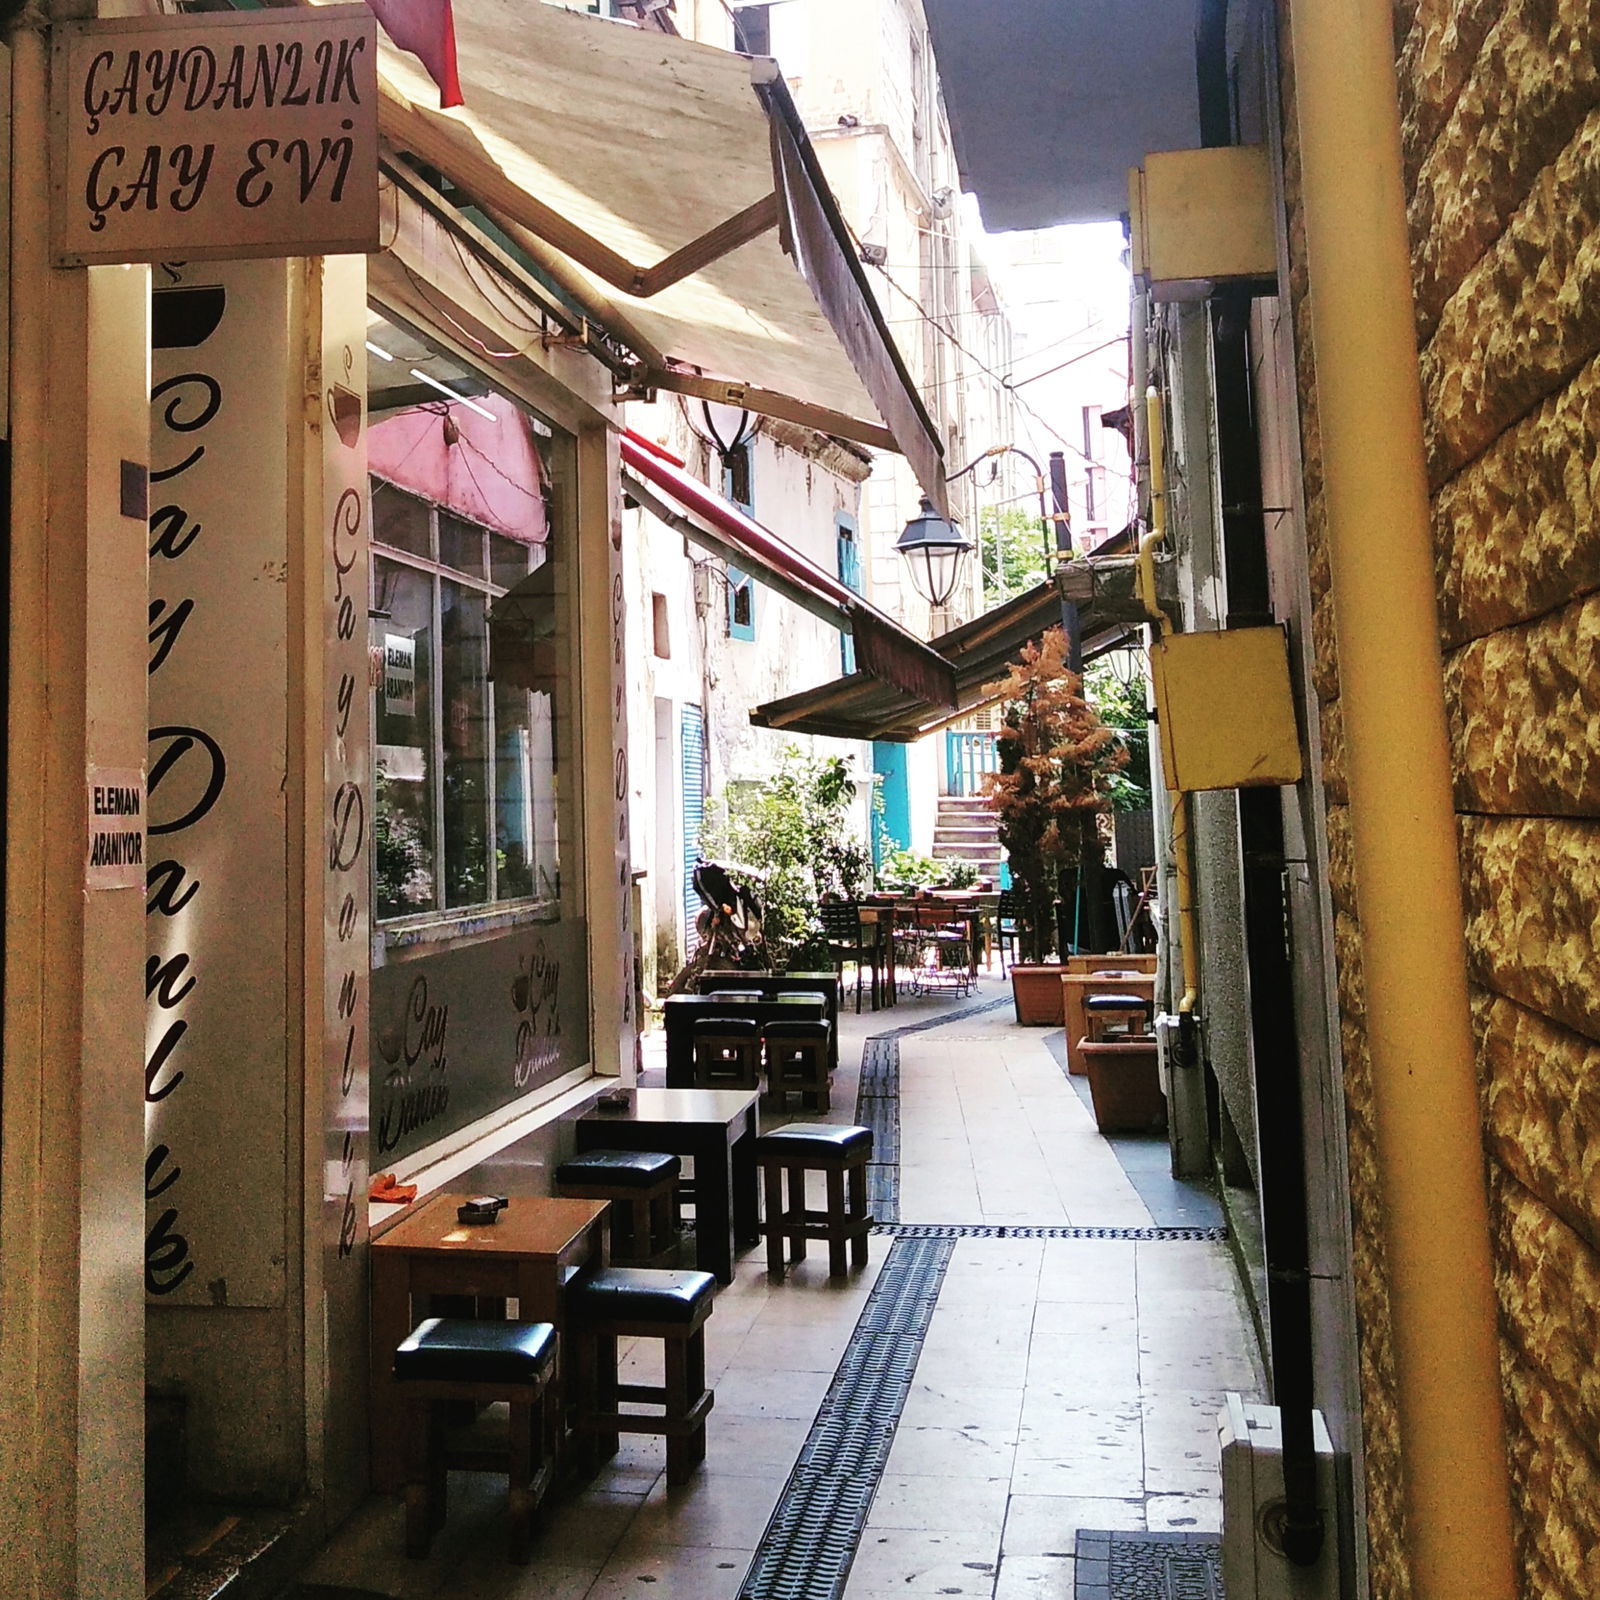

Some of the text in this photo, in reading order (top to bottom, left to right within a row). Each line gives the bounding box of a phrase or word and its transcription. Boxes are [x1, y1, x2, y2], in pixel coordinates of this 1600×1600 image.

[84, 37, 366, 135] ÇAYDANLIK
[86, 119, 354, 232] ÇAY EVİ
[94, 787, 140, 815] ELEMAN
[90, 832, 142, 866] ARANIYOR
